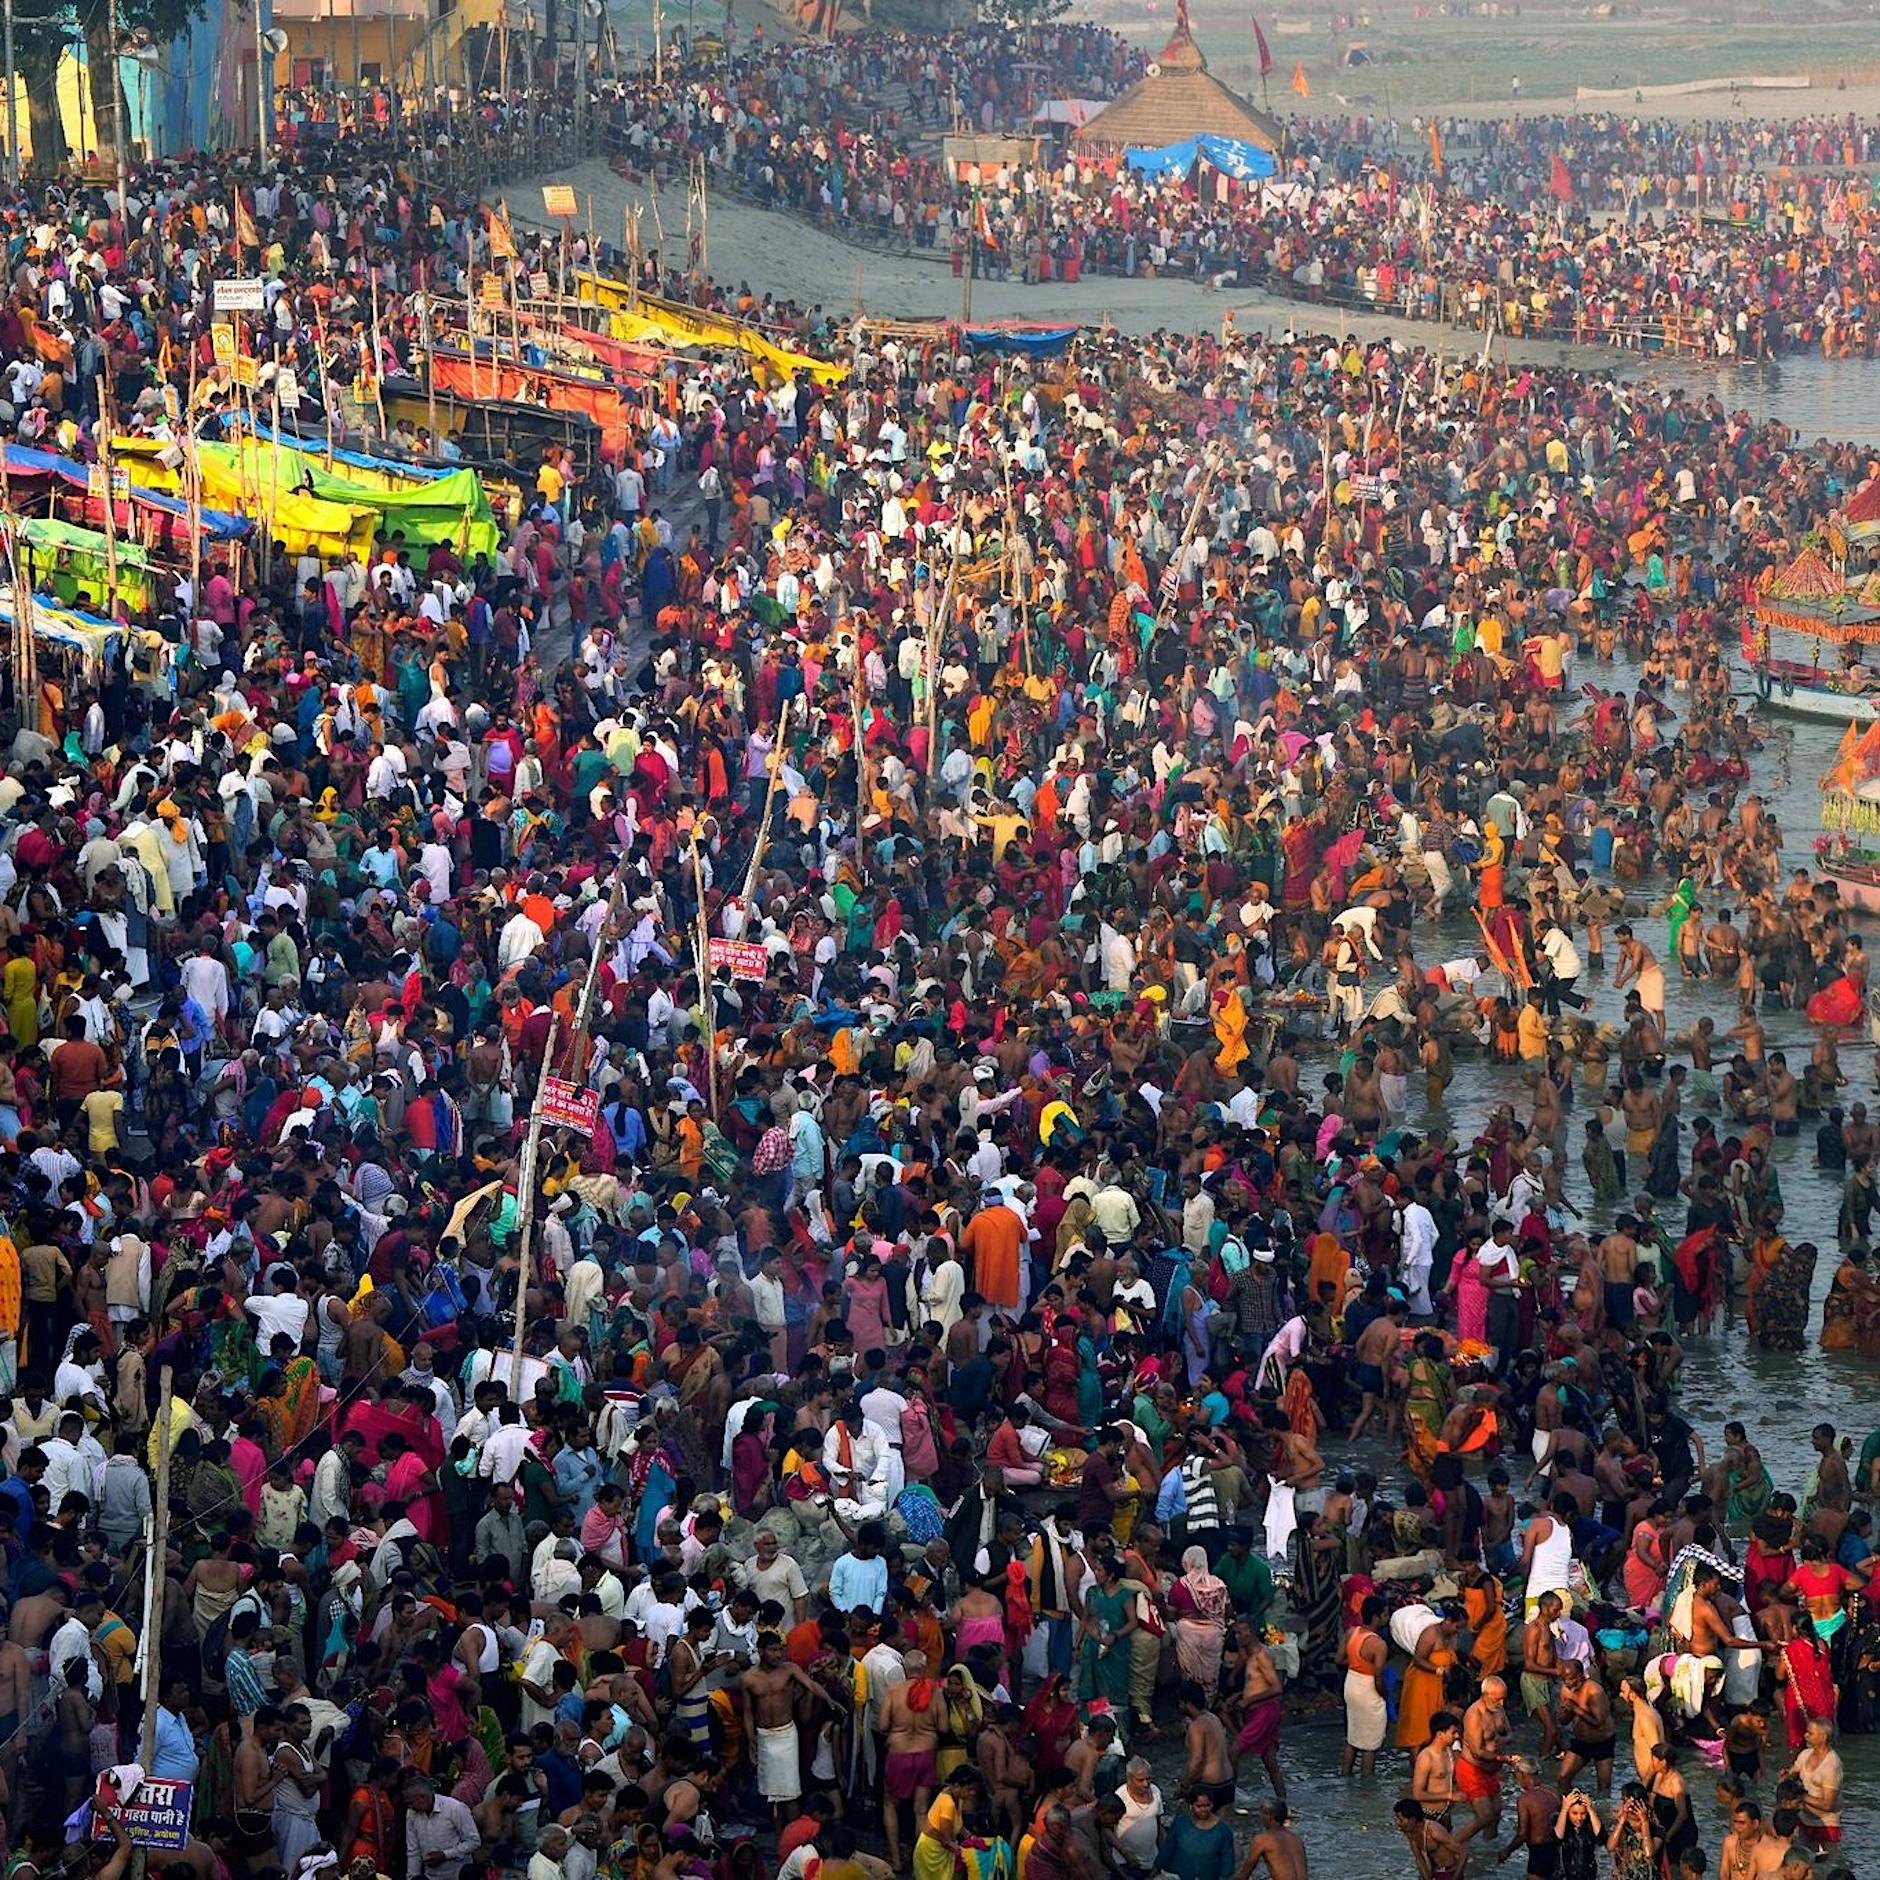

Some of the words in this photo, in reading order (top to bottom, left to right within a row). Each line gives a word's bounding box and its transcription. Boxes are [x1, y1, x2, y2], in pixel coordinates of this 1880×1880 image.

[137, 1782, 177, 1806] तरा
[109, 1803, 122, 1820] गे
[150, 1809, 175, 1826] पानी
[175, 1809, 186, 1827] है
